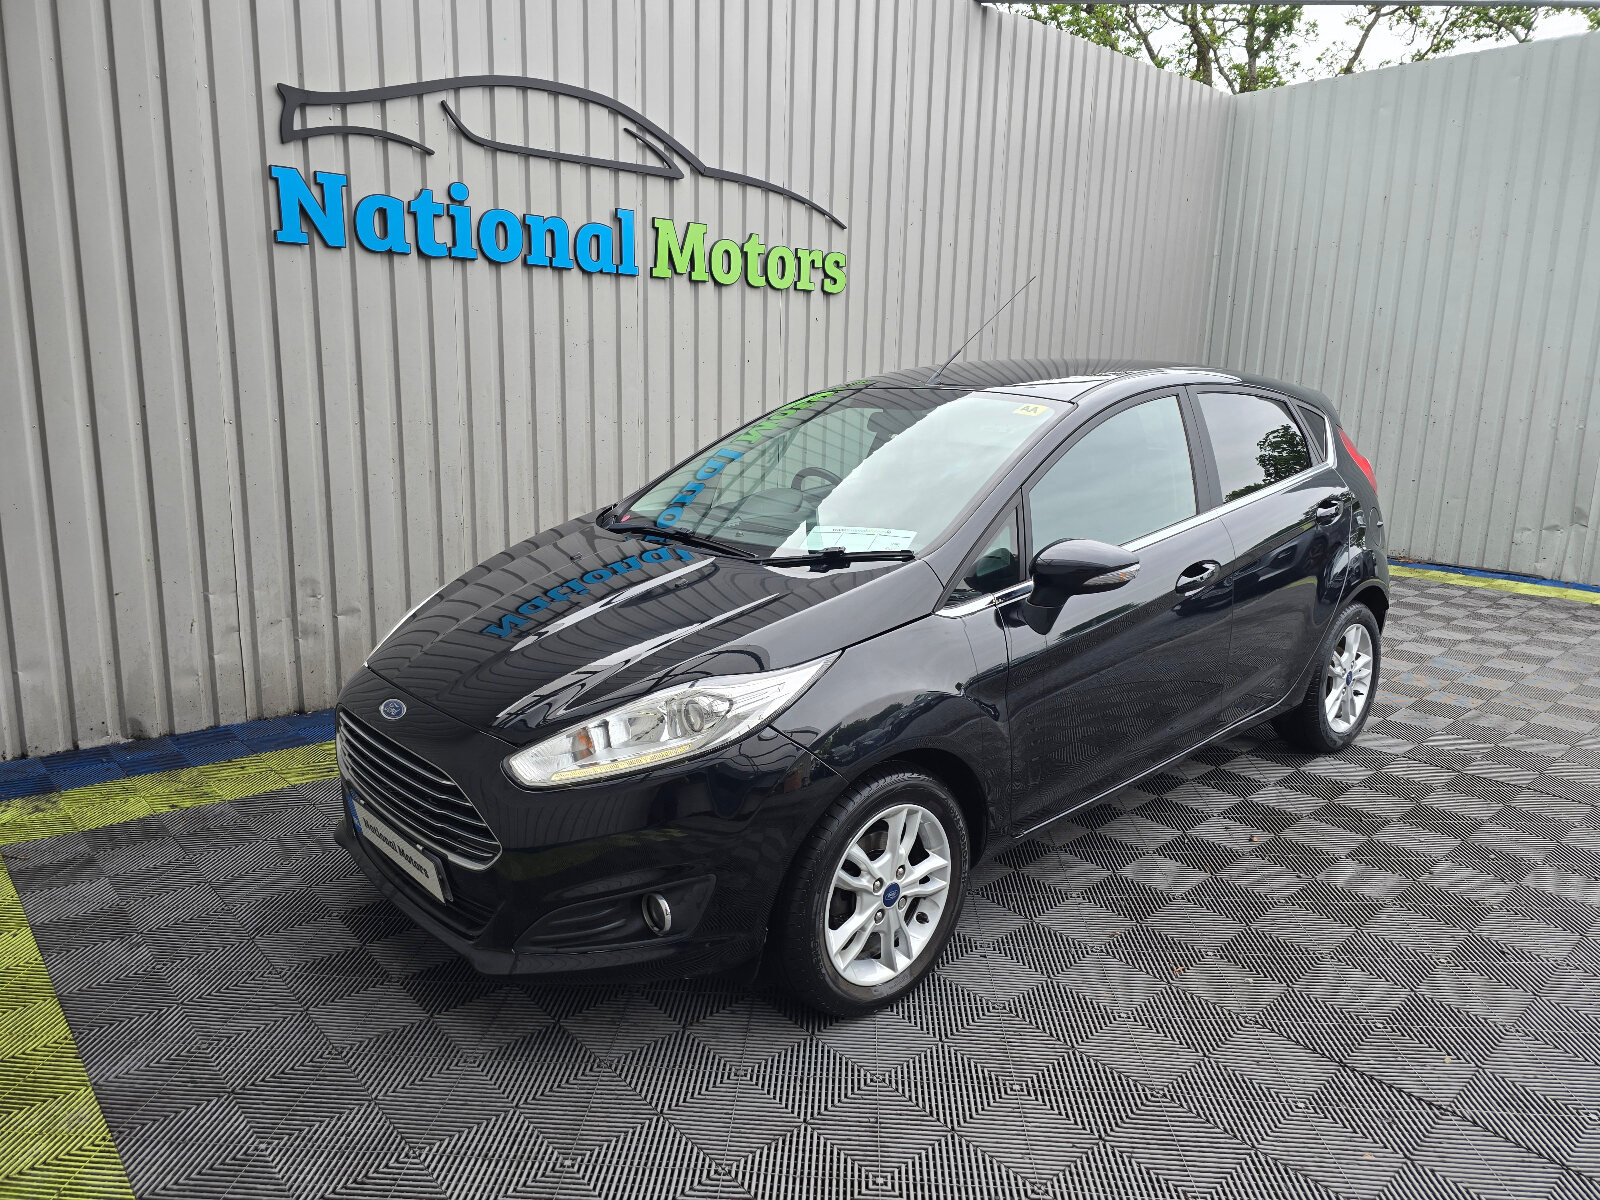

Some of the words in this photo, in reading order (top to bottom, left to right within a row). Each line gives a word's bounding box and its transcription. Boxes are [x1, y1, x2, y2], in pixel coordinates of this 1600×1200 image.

[269, 164, 639, 277] National
[651, 216, 847, 295] Motors
[1020, 405, 1039, 414] AA
[362, 816, 399, 854] National
[397, 845, 430, 879] Motors
